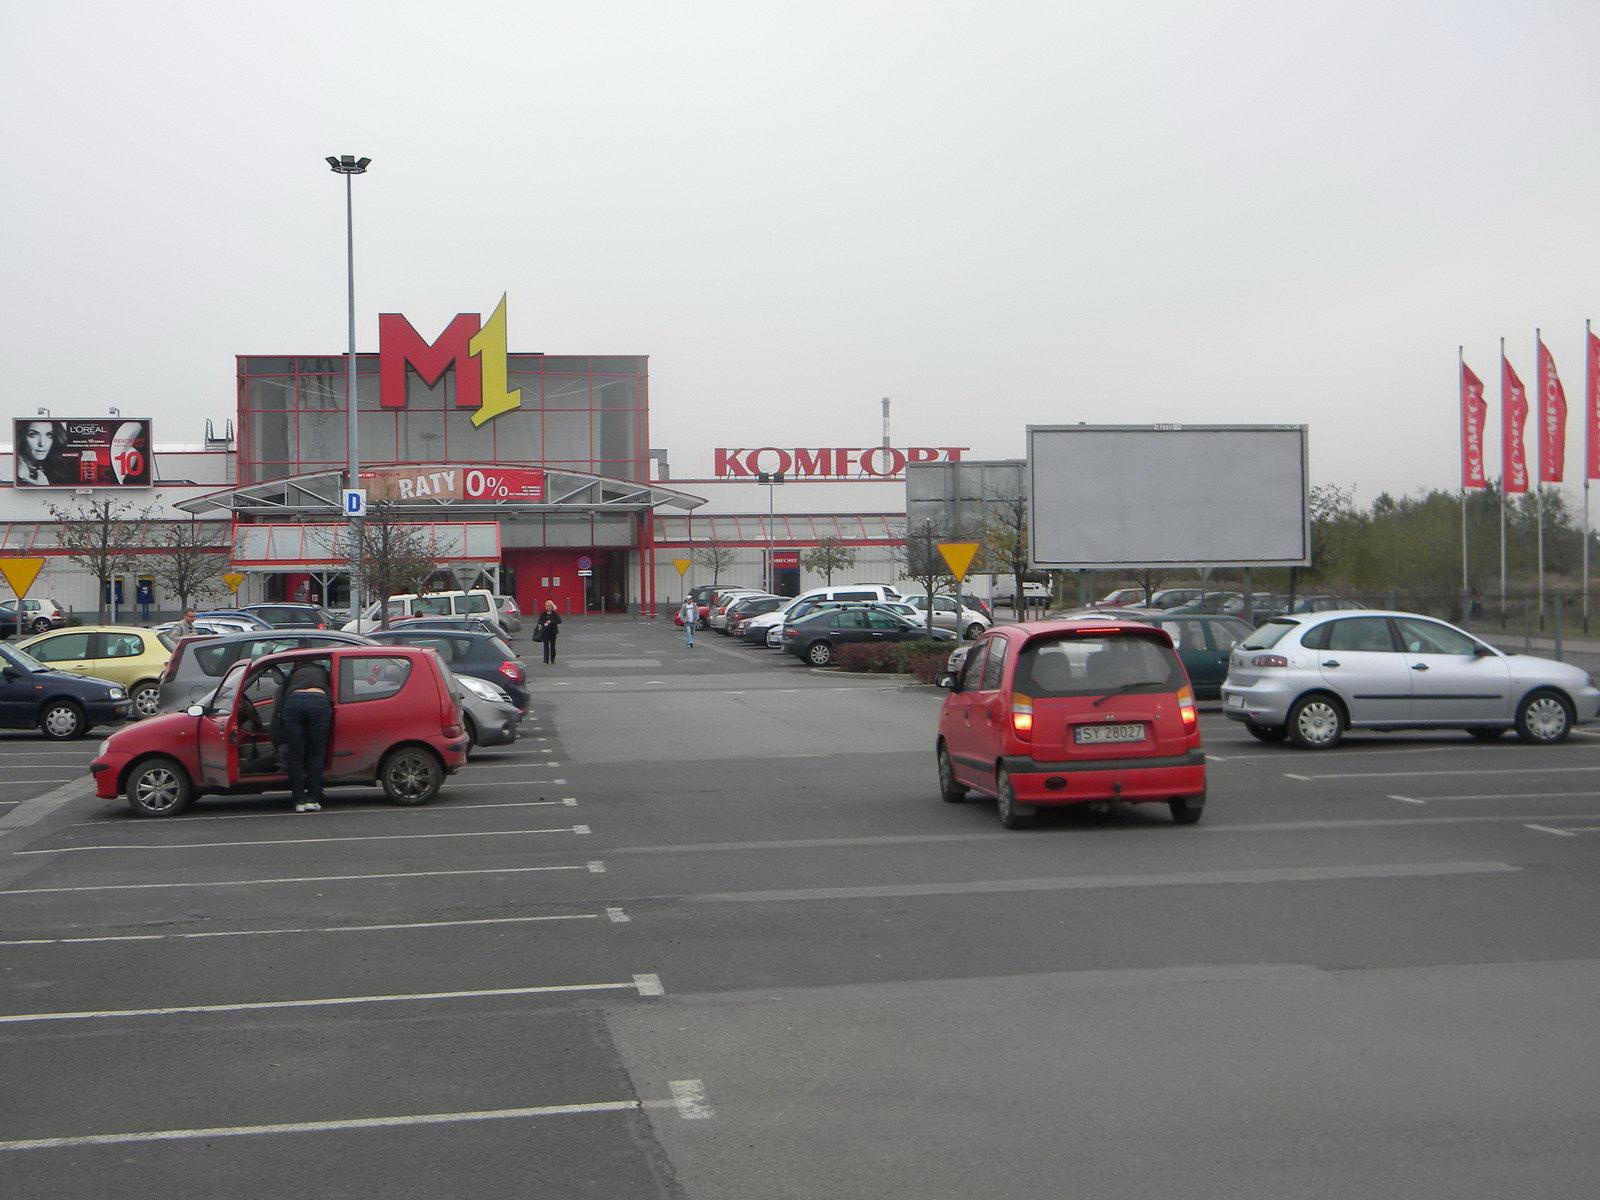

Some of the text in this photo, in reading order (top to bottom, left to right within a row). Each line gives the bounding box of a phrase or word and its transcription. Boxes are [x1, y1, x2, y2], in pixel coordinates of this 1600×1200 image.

[379, 291, 522, 428] M1
[114, 451, 144, 477] 10
[398, 470, 509, 500] RATY 0%
[348, 493, 361, 512] D
[1083, 725, 1142, 740] SY 28027
